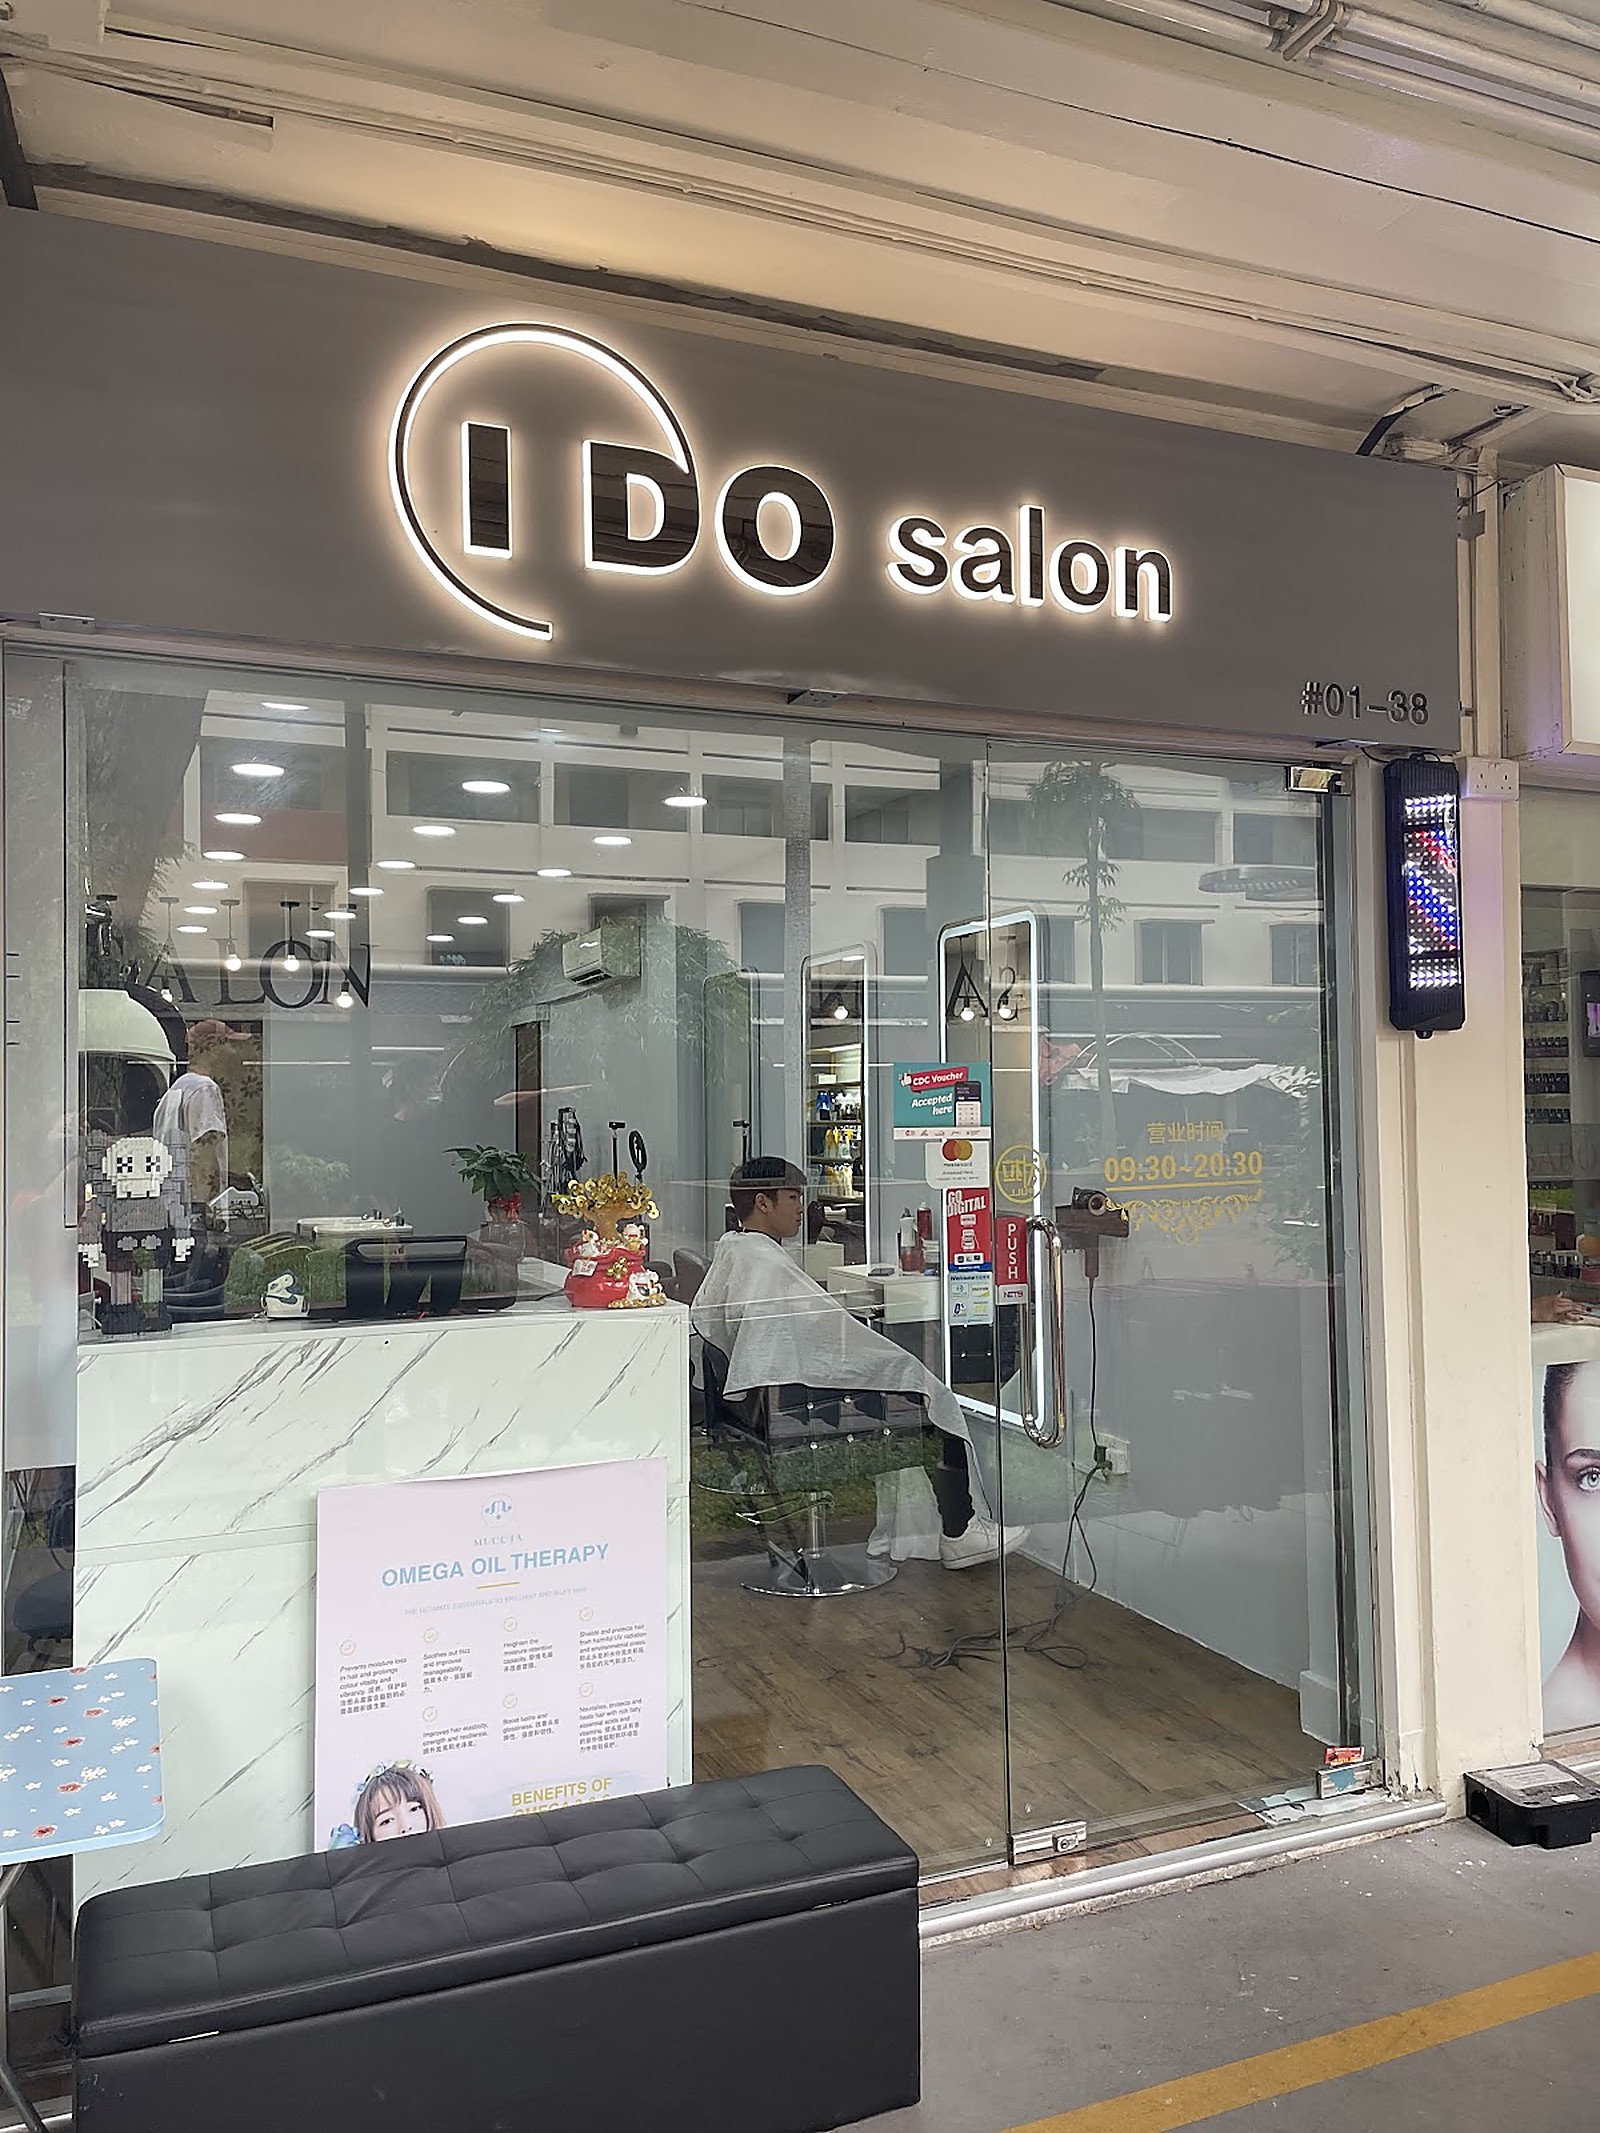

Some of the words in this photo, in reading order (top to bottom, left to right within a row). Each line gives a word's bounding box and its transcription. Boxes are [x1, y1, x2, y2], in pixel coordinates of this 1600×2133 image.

[461, 422, 511, 559] I
[583, 439, 837, 596] DO
[886, 504, 1173, 623] salon
[1301, 681, 1429, 726] #01-38
[110, 938, 381, 1009] ALON
[913, 1076, 930, 1085] CDC
[932, 1072, 963, 1083] Voucher
[912, 1093, 953, 1108] Accepted
[932, 1106, 953, 1115] here
[1148, 1120, 1224, 1144] 营业时间
[947, 1196, 986, 1217] DIGITAL
[948, 1190, 962, 1203] GO
[1007, 1223, 1018, 1280] PUSH
[382, 1561, 464, 1587] OMEGA
[471, 1557, 506, 1575] OIL
[511, 1543, 608, 1570] THERAPY
[512, 1781, 587, 1806] BENEFITS
[592, 1777, 612, 1793] OF
